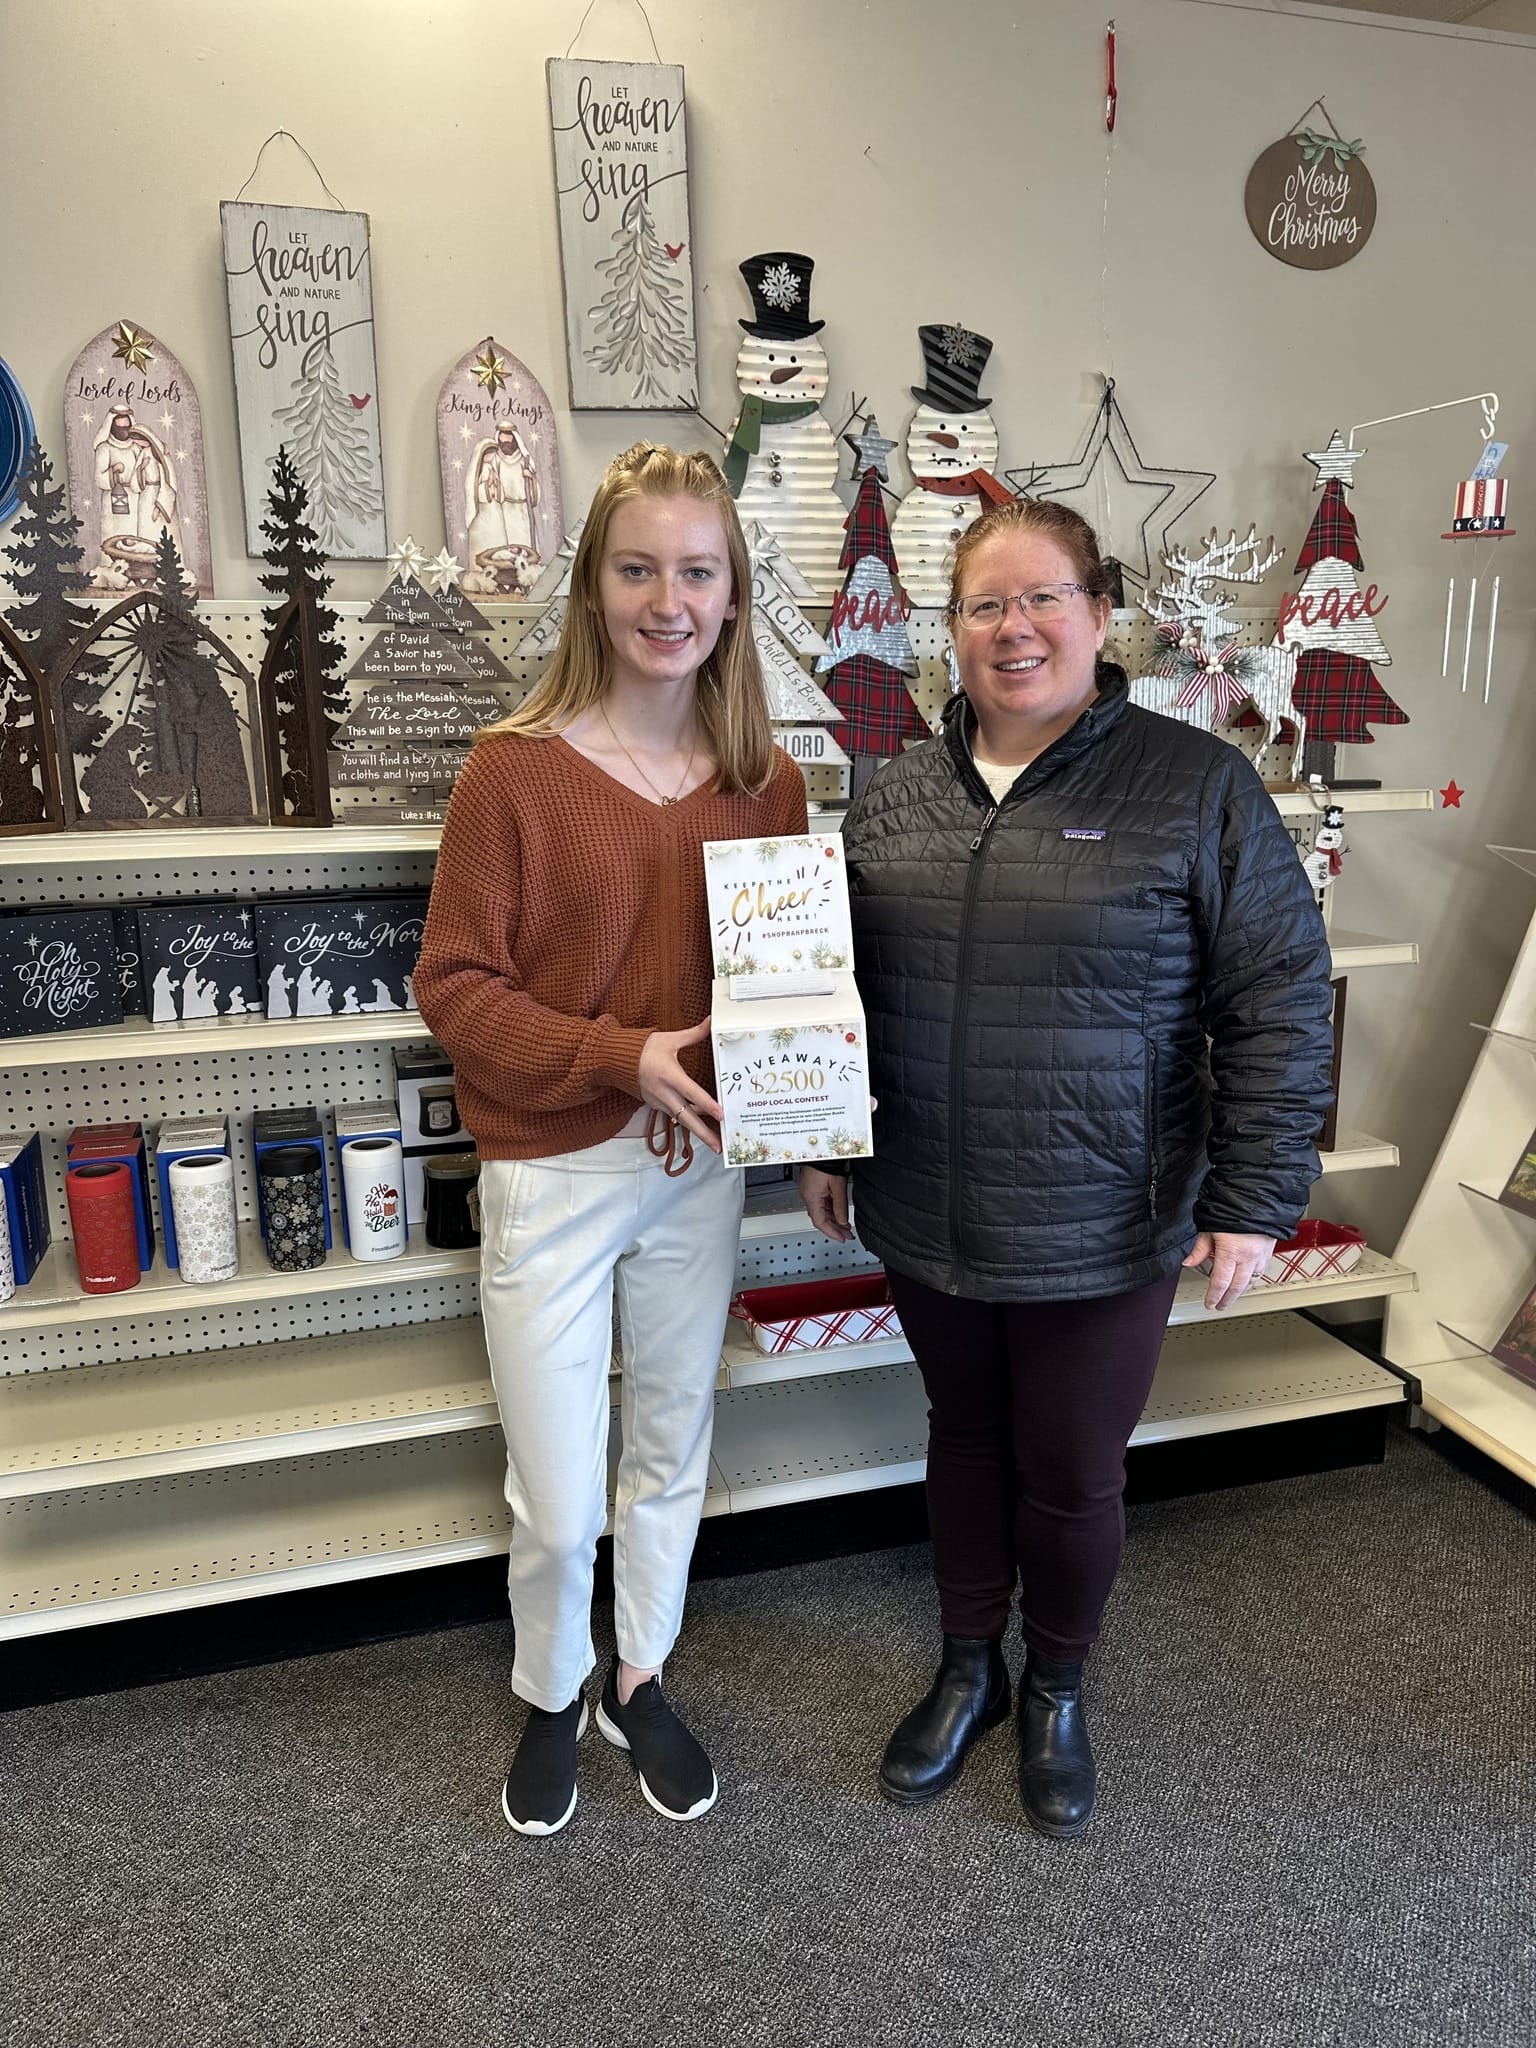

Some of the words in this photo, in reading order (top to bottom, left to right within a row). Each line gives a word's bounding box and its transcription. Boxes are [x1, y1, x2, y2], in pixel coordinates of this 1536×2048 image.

[611, 87, 629, 98] LET
[565, 76, 684, 150] heaven
[602, 141, 621, 151] AND
[625, 142, 659, 152] NATURE
[570, 156, 660, 224] sing
[1285, 165, 1351, 213] Merry
[1268, 202, 1362, 250] Christmas
[289, 232, 308, 244] LET
[243, 221, 368, 296] heaven
[280, 287, 300, 298] AND
[304, 288, 341, 300] NATURE
[247, 303, 342, 370] sing
[75, 376, 117, 401] Lord
[118, 381, 135, 405] of
[137, 380, 182, 404] Lords
[446, 393, 483, 422] King
[486, 400, 501, 420] of
[502, 398, 544, 425] Kings
[391, 585, 420, 599] Today
[401, 597, 410, 606] in
[434, 594, 464, 608] Today
[385, 609, 405, 620] the
[408, 608, 430, 620] town
[1278, 584, 1389, 644] peace
[383, 632, 396, 644] of
[400, 633, 430, 644] David
[450, 640, 473, 651] avid
[373, 650, 381, 658] a
[386, 647, 420, 659] Savior
[423, 648, 443, 659] has
[364, 661, 390, 672] been
[394, 661, 417, 672] born
[420, 662, 431, 673] to
[756, 635, 791, 668] Child
[783, 666, 801, 686] Is
[797, 683, 826, 716] Born
[367, 692, 380, 703] he
[383, 692, 393, 702] is
[396, 690, 414, 702] the
[367, 706, 402, 720] The
[406, 706, 461, 721] Lord
[347, 725, 367, 736] This
[369, 726, 385, 735] will
[388, 723, 402, 735] be
[405, 727, 413, 735] a
[416, 725, 440, 737] sign
[443, 722, 455, 735] to
[341, 754, 358, 766] You
[359, 752, 377, 766] will
[379, 751, 400, 766] find
[402, 755, 410, 765] a
[337, 770, 347, 781] in
[350, 769, 380, 780] cloths
[383, 769, 401, 780] and
[405, 769, 429, 783] lying
[433, 769, 442, 779] in
[445, 770, 452, 779] a
[401, 811, 419, 820] Luke
[724, 881, 757, 890] KEEP
[731, 882, 814, 927] Cheer
[777, 914, 817, 923] HERE!
[169, 924, 222, 967] Joy
[223, 931, 237, 941] to
[232, 937, 254, 950] the
[284, 923, 337, 966] Joy
[338, 930, 352, 941] to
[347, 937, 369, 950] the
[370, 919, 424, 947] Wor
[40, 941, 80, 966] Oh
[13, 961, 100, 986] Holy
[23, 978, 99, 1018] Night
[732, 1053, 846, 1082] GIVEAWAY!
[750, 1068, 825, 1095] $2500
[769, 1098, 794, 1106] LOCAL
[794, 1095, 829, 1104] CONTEST
[371, 1183, 389, 1198] Ho
[365, 1194, 380, 1207] Ho
[364, 1206, 383, 1219] Hold
[371, 1215, 400, 1232] Beer
